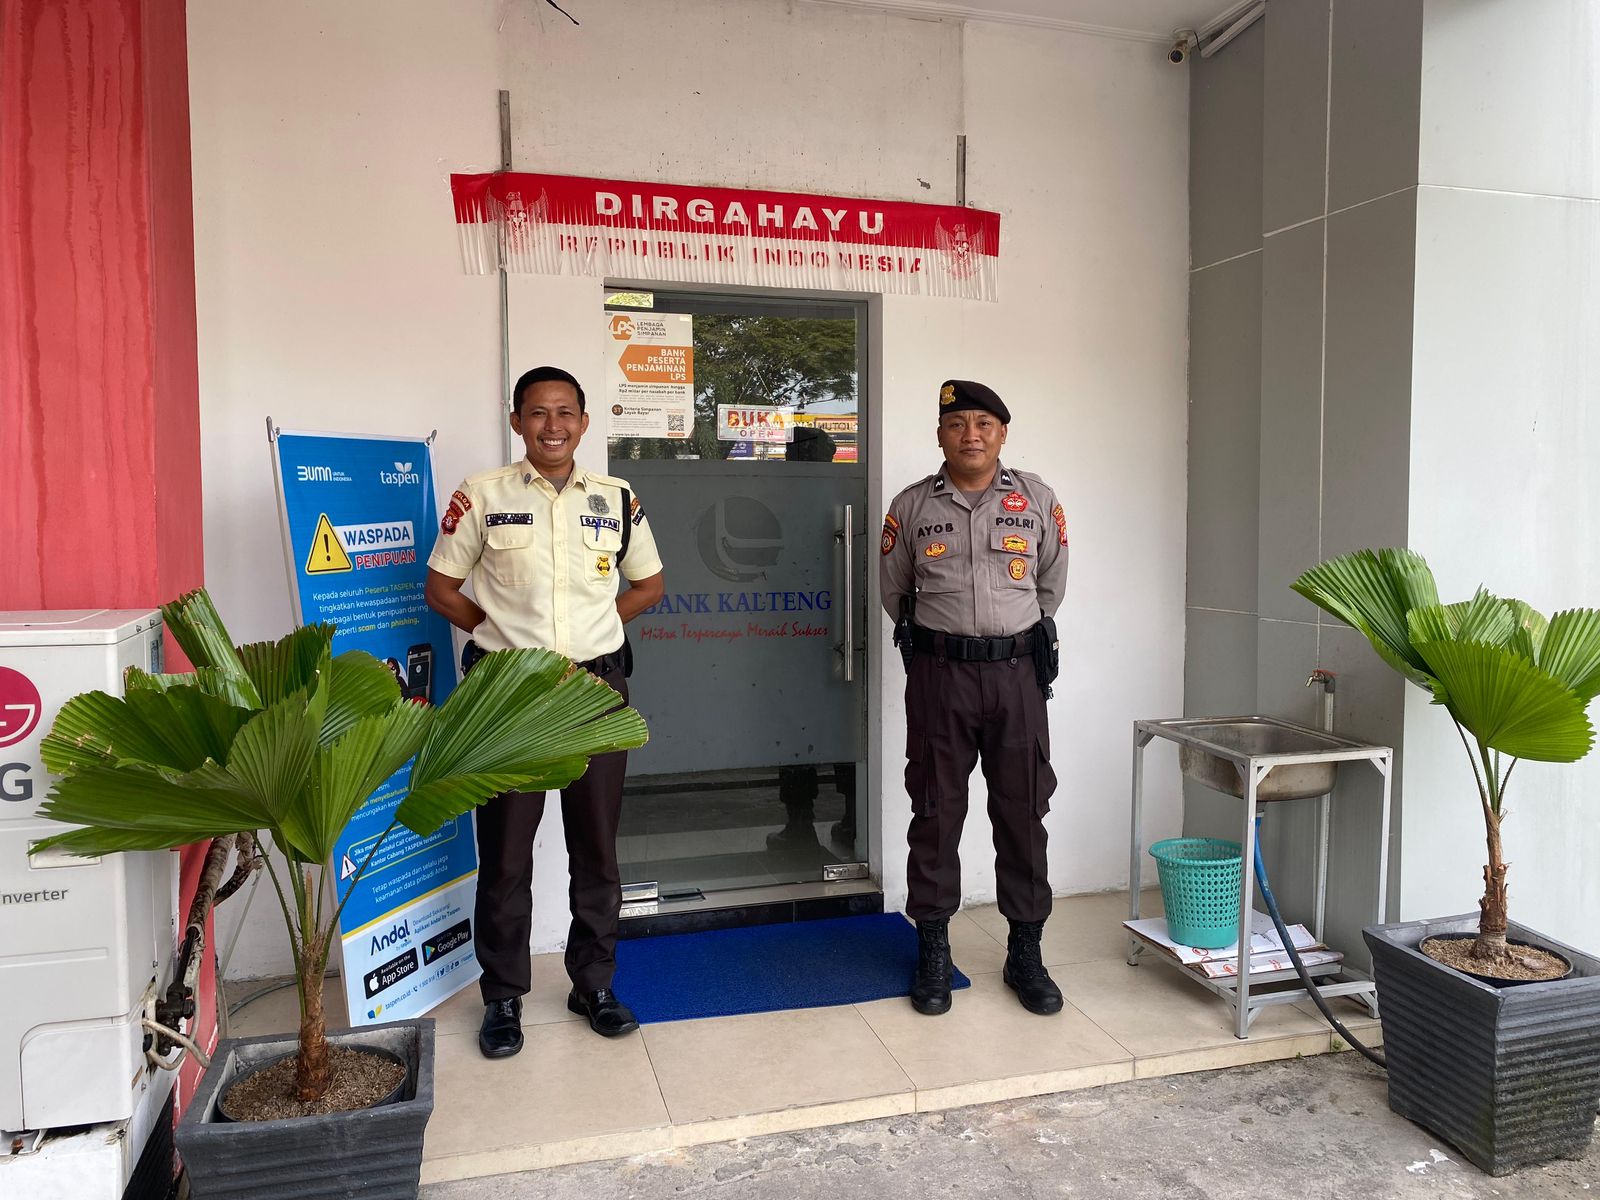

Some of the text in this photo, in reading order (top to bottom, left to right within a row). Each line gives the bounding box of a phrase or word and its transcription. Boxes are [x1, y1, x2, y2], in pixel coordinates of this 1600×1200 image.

[595, 191, 884, 235] DIRGAHAYU
[559, 234, 922, 274] REPUBLIK INDONESIA
[647, 356, 686, 365] PESERTA
[661, 348, 686, 357] BANK
[626, 363, 686, 373] PENJAMINAN
[670, 373, 687, 381] LPS
[727, 410, 785, 429] BUKA
[739, 429, 774, 438] OPEN
[380, 470, 419, 487] taspen
[917, 522, 954, 538] AYOB
[995, 516, 1034, 530] POLRI
[343, 525, 411, 546] WASPADA
[355, 549, 417, 571] PENIPUAN
[312, 591, 339, 601] Kepada
[339, 588, 364, 598] seluruh
[365, 586, 389, 594] Peserta
[319, 593, 425, 614] tingkatkan kewaspadaan terhada
[717, 590, 832, 612] KALTENG
[322, 605, 429, 625] berbagai bentuk penipuan daring
[335, 626, 357, 636] seperti
[358, 624, 376, 632] scam
[377, 621, 390, 630] dan
[640, 621, 828, 644] Mitra Terpercaya Meraih Sukses
[0, 762, 33, 802] G
[372, 855, 449, 894] Tetap waspada dan selalu jaga
[375, 865, 448, 904] keamanan data pribadi Anda
[0, 889, 69, 904] nverter
[370, 919, 410, 956] Andal
[437, 937, 458, 953] Google
[457, 930, 469, 942] Play
[382, 961, 415, 986] App Store
[385, 989, 412, 1010] taspen.co.id
